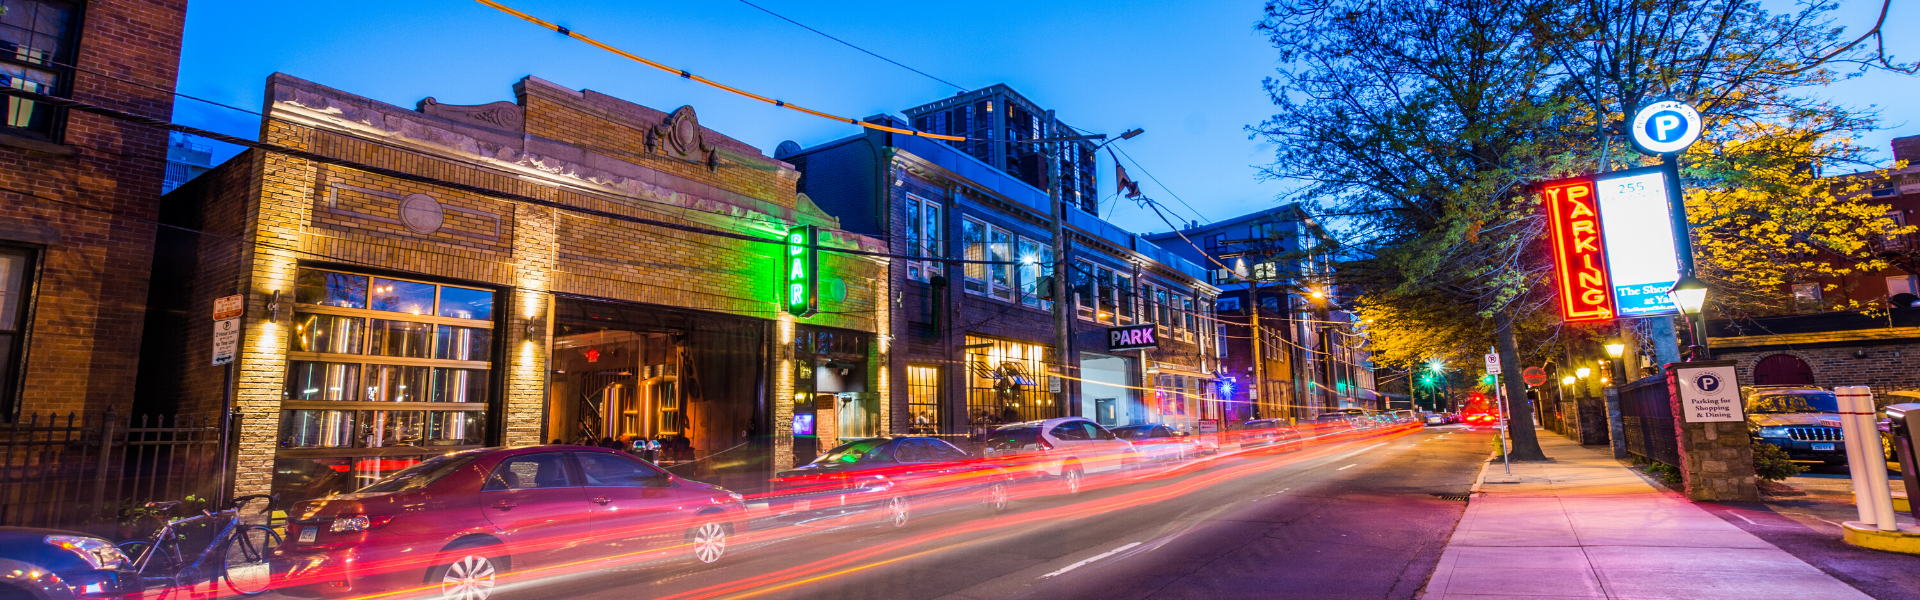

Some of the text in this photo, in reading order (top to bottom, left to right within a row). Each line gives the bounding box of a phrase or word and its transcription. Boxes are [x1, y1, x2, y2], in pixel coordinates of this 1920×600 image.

[1655, 115, 1679, 141] P
[1617, 181, 1645, 194] 255
[1567, 186, 1605, 305] PARKING
[790, 234, 803, 305] BAR
[1618, 286, 1641, 297] The
[1111, 328, 1155, 347] PARK
[1702, 377, 1714, 390] P
